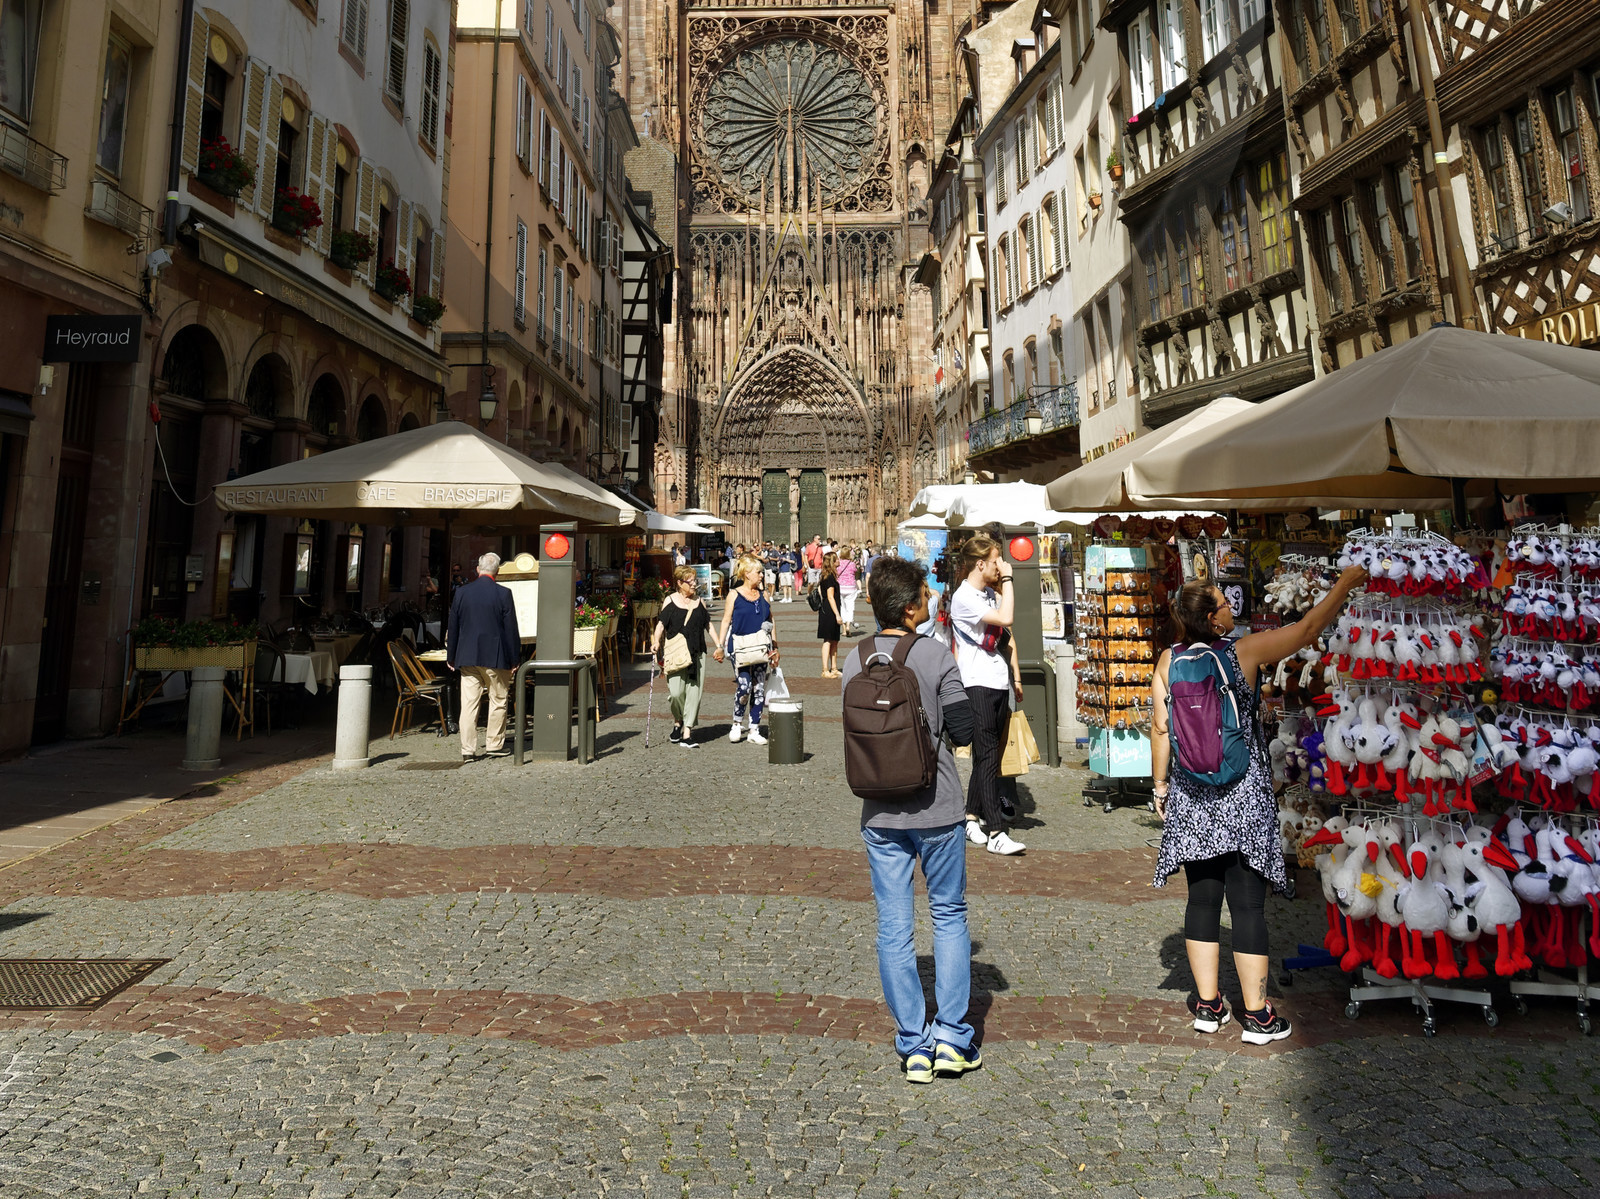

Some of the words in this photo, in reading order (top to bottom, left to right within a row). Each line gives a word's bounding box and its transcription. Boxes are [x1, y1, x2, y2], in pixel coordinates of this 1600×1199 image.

[56, 328, 130, 349] Heyraud
[224, 487, 328, 505] RESTAURANT
[356, 487, 396, 501] CAFE
[423, 487, 512, 503] BRASSERIE
